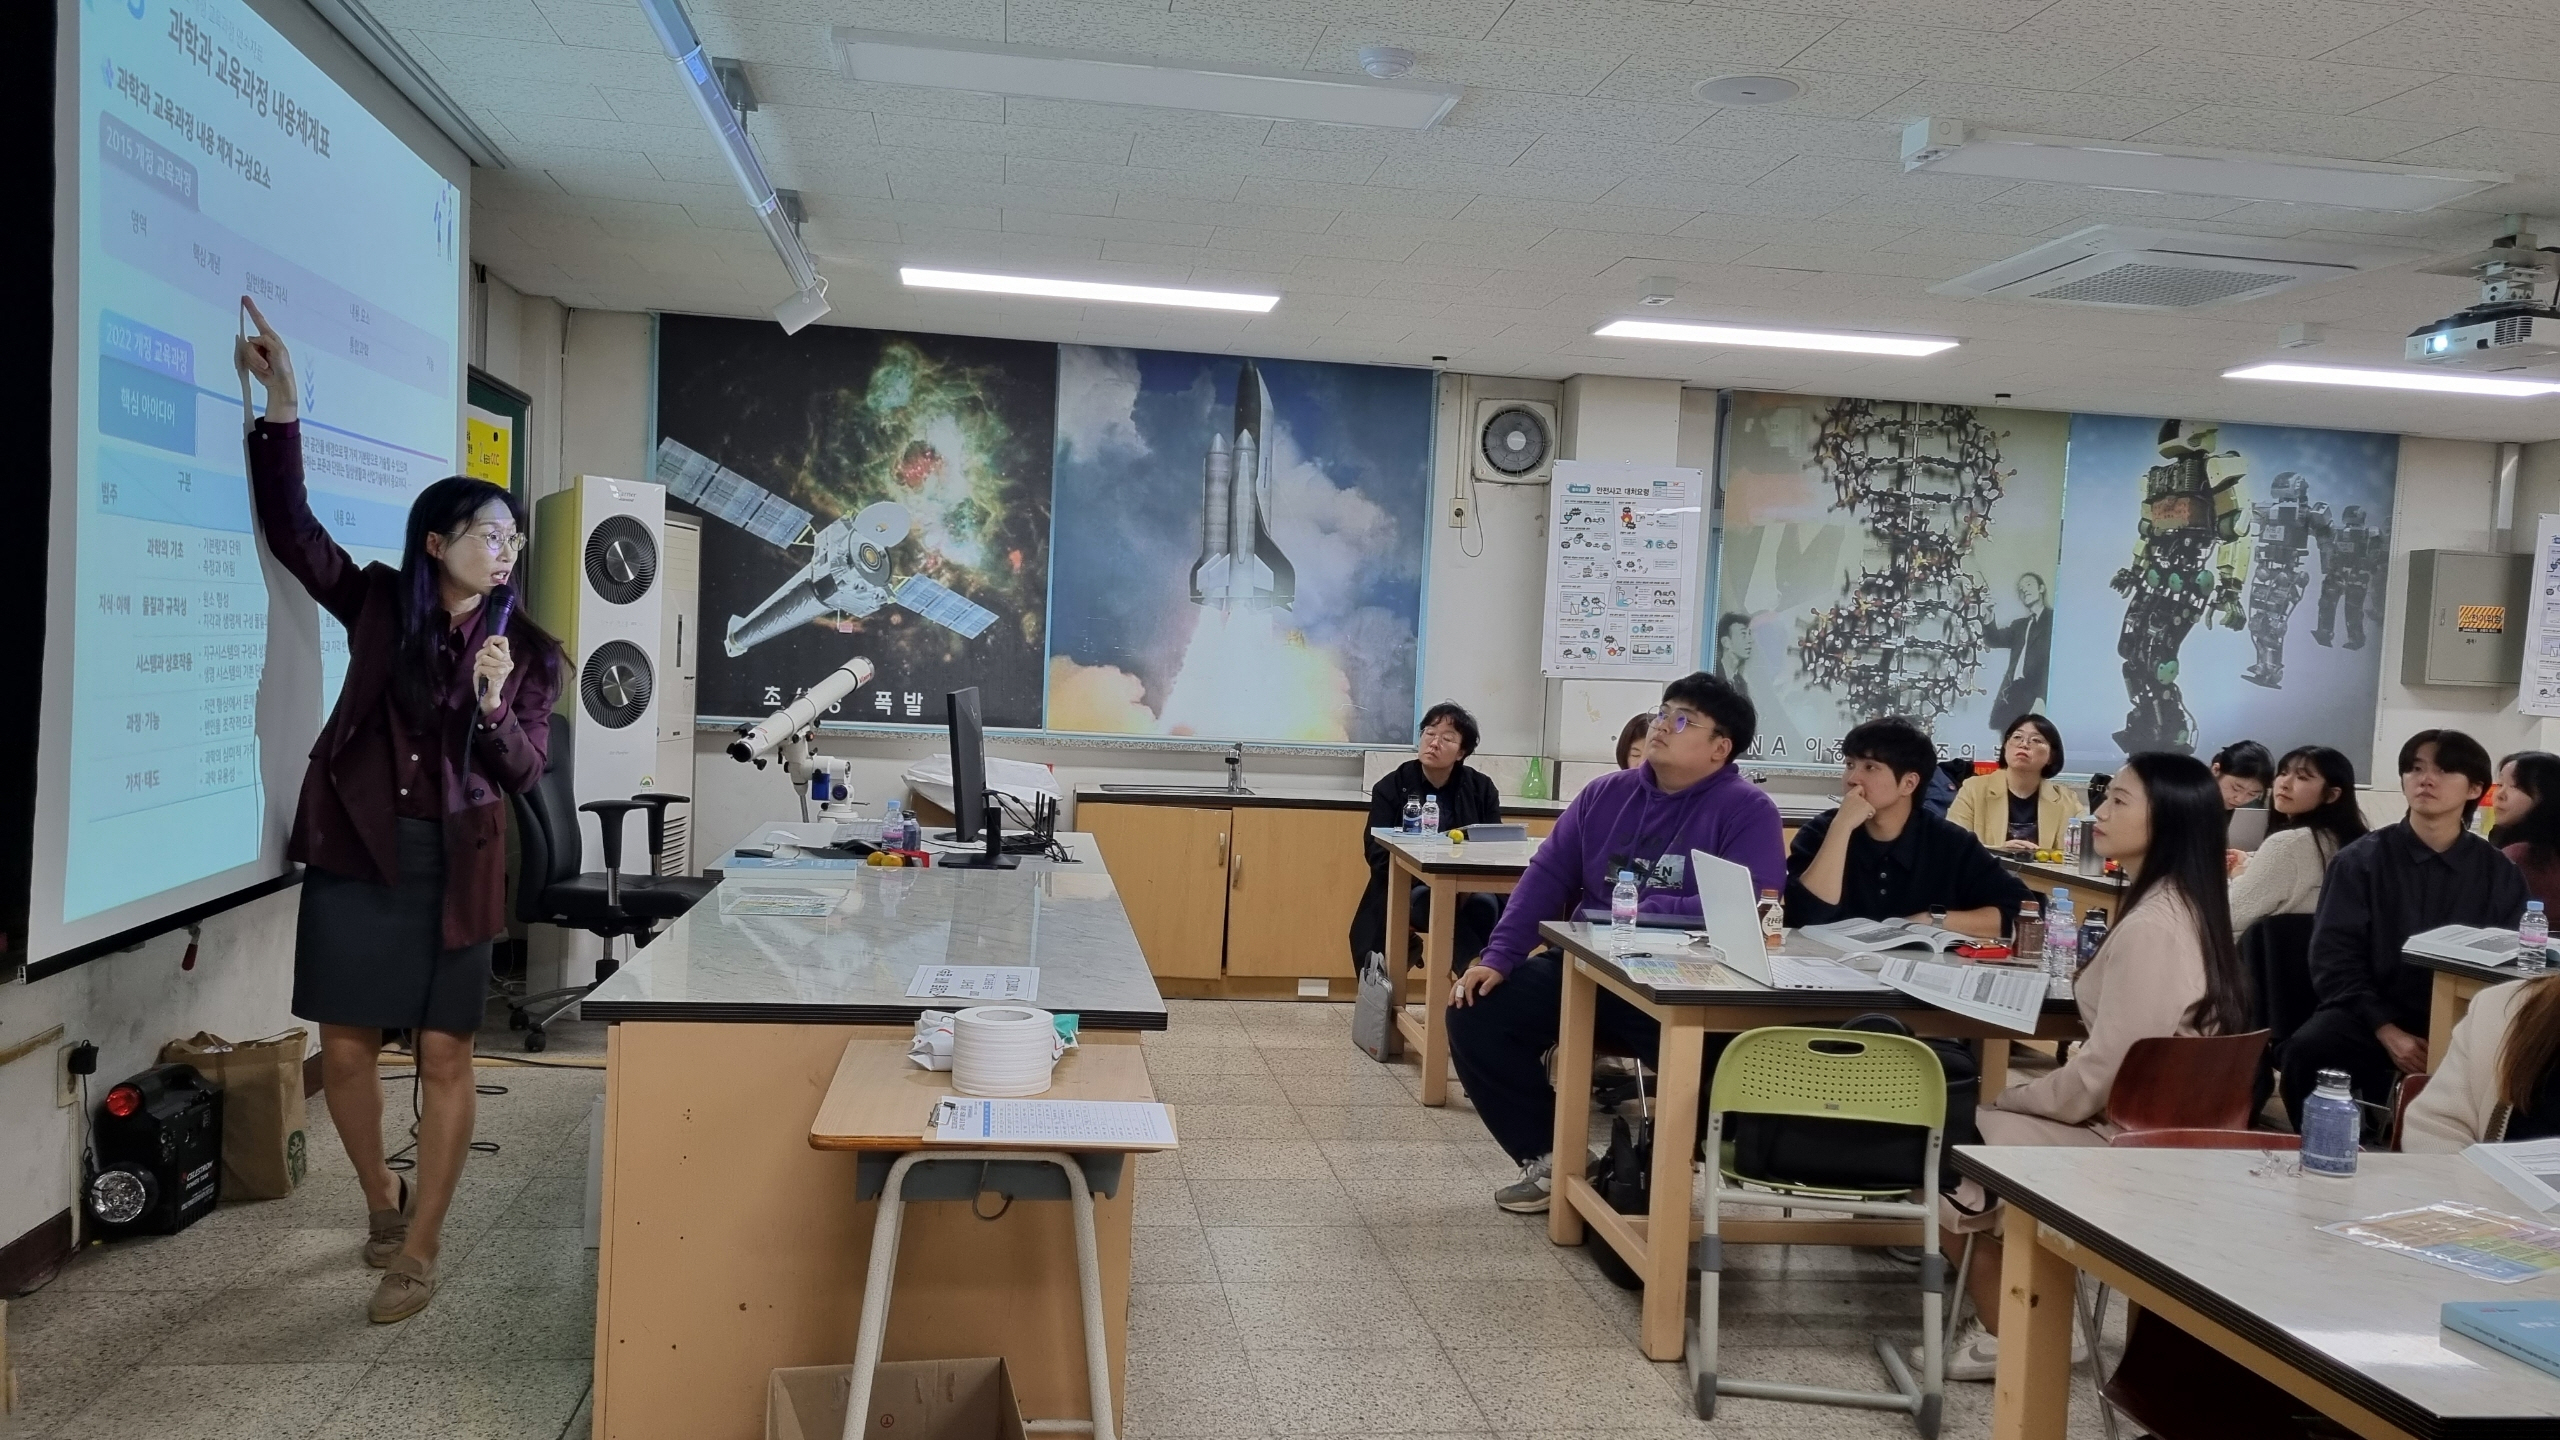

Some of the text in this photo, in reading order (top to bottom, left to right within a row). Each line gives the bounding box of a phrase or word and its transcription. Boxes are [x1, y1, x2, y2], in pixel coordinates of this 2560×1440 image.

[168, 7, 331, 159] 과학과 교육과정 내용체계표
[117, 65, 151, 115] 과학과
[152, 91, 194, 142] 교육과정
[196, 120, 215, 156] 내용
[106, 125, 192, 198] 2015 개정 교육과정
[131, 209, 147, 237] 영역
[192, 242, 206, 269] 핵심
[245, 271, 274, 300] 일반화된
[275, 285, 288, 306] 지식
[350, 303, 360, 322] 내용
[361, 309, 370, 325] 요소
[106, 323, 188, 376] 2022 개정 교육과정
[121, 388, 175, 427] 핵심 아이디어
[101, 481, 118, 505] 범주
[177, 471, 356, 527] 구분 내용 요소
[1596, 486, 1622, 495] 안전사고
[1624, 487, 1650, 497] 대처요령
[147, 537, 241, 560] 과학의 기초 기본량과 단위
[203, 560, 236, 577] 측정과 어림
[143, 597, 164, 617] 물질과
[166, 597, 187, 617] 규칙성
[136, 653, 165, 674] 시스템과
[165, 652, 193, 673] 상호작용
[874, 690, 924, 717] 폭발
